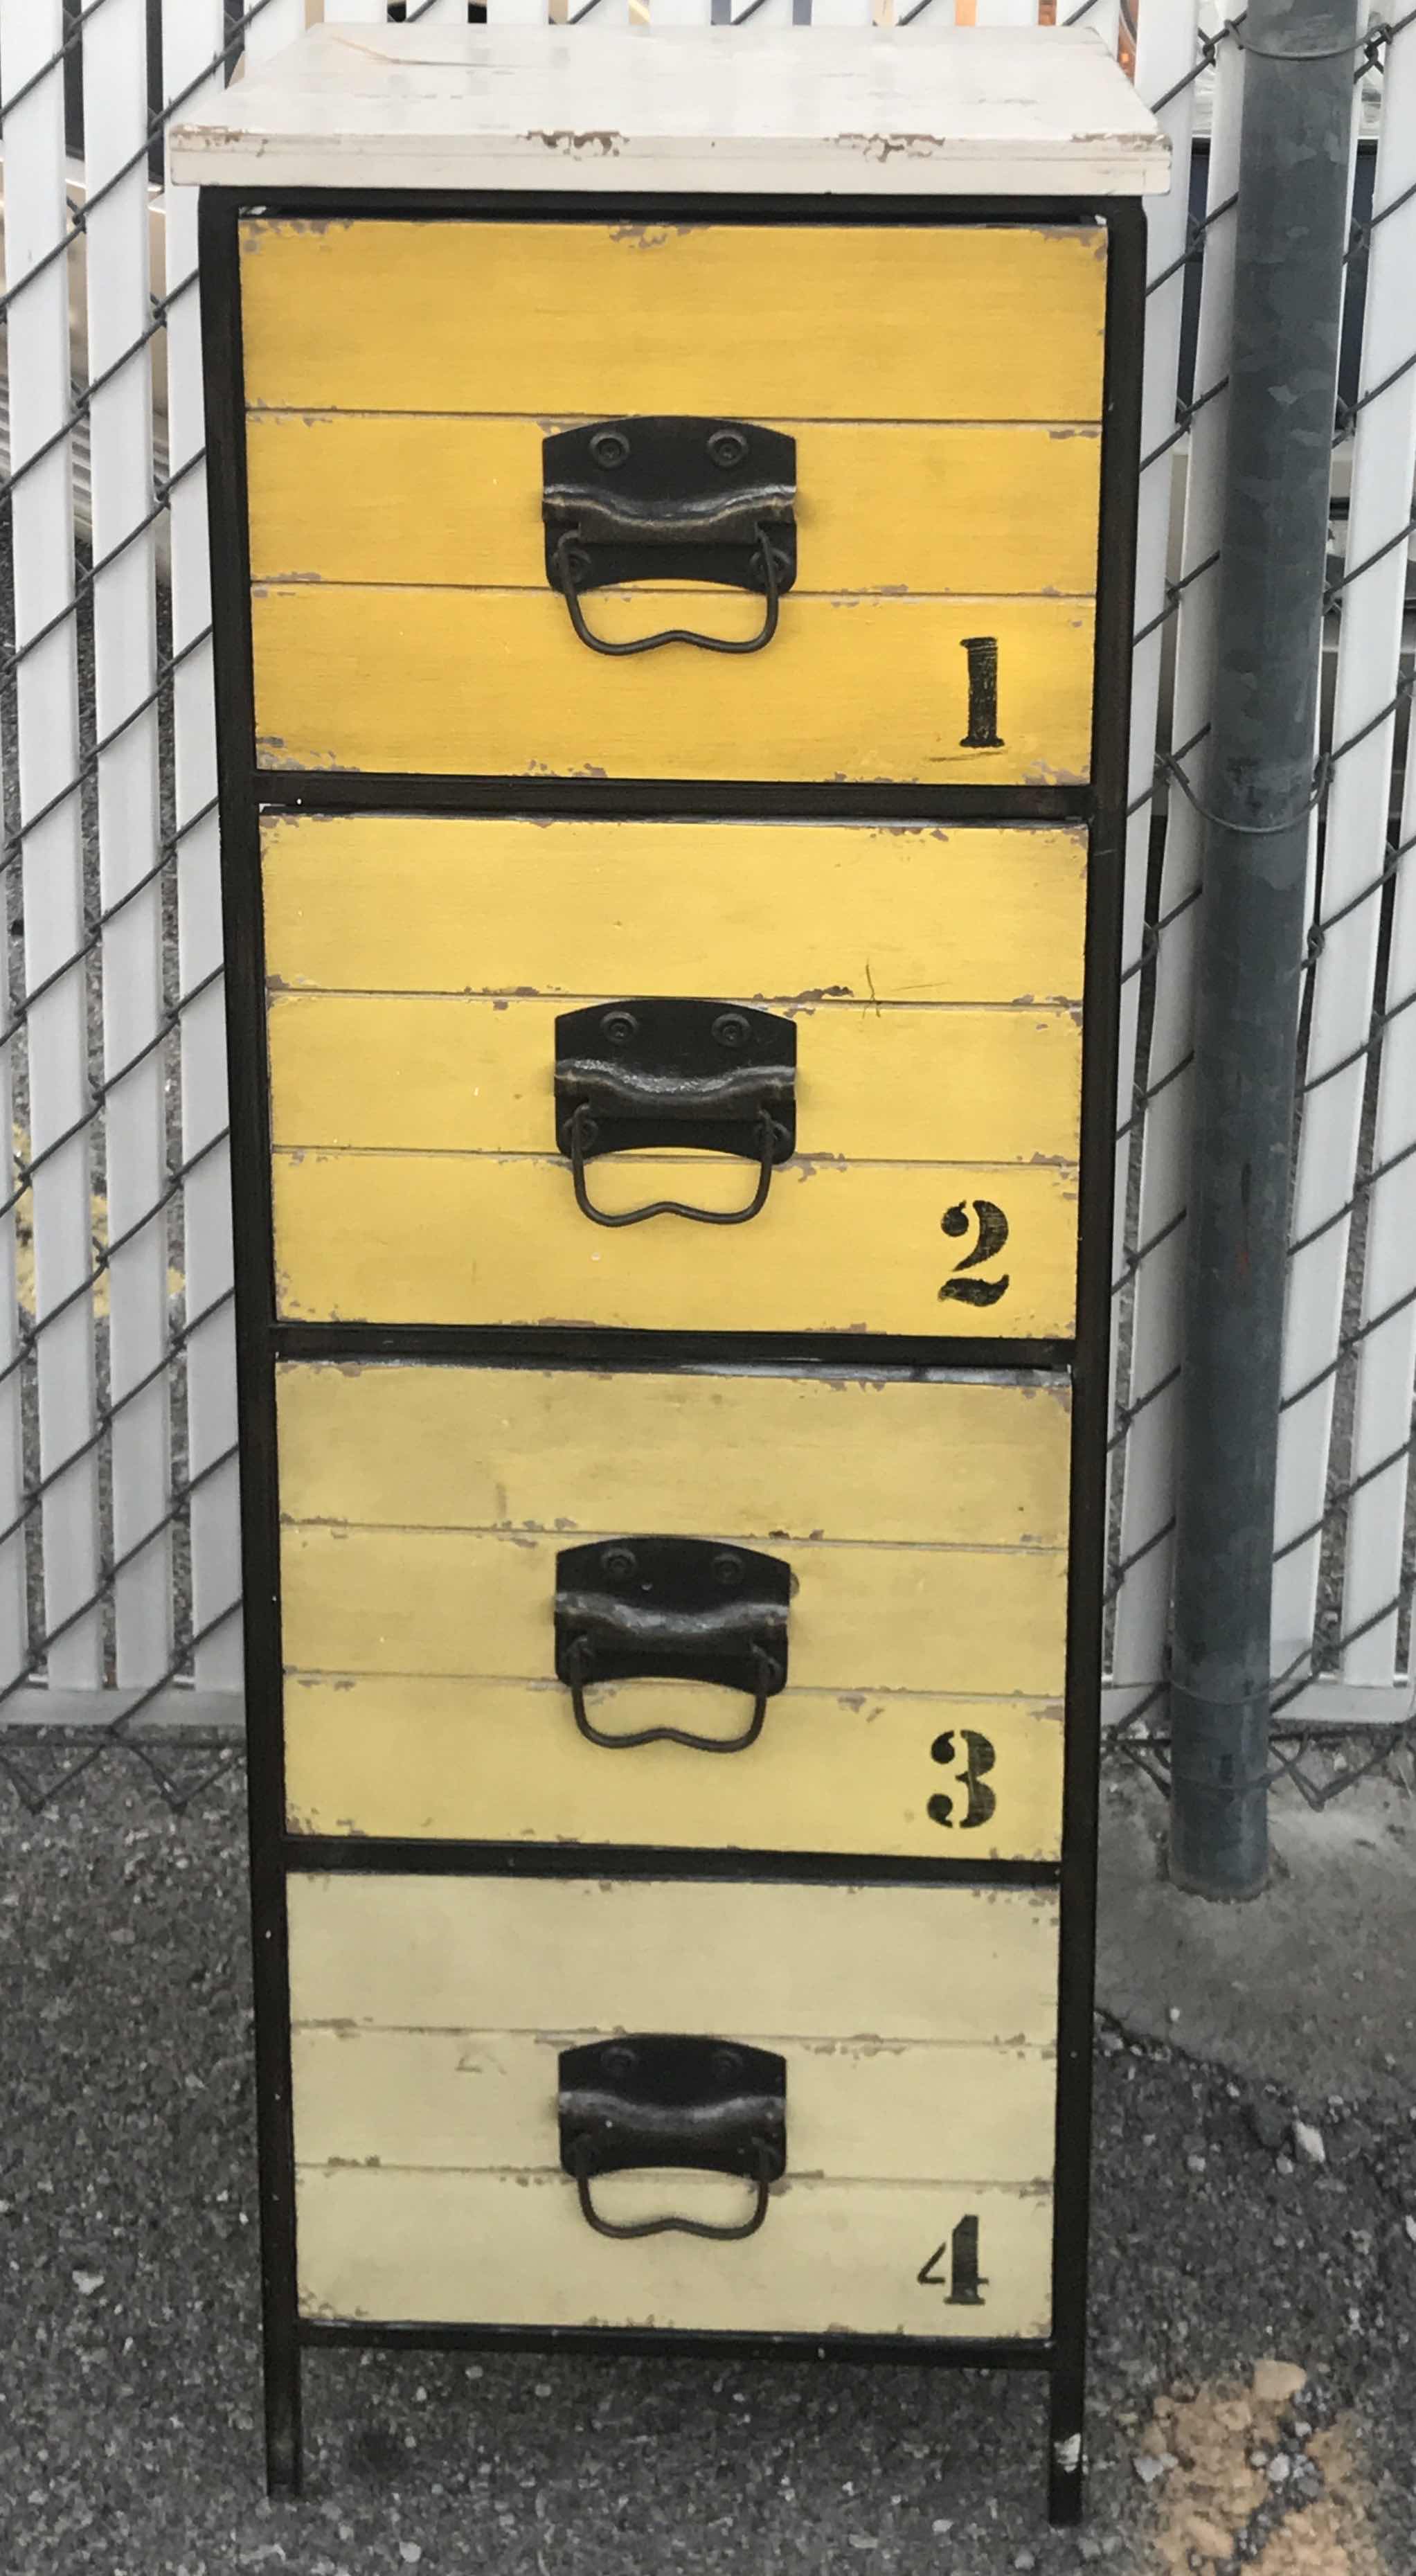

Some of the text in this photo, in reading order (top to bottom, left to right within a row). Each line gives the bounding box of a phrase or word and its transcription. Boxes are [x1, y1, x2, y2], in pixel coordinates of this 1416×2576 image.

[960, 636, 1005, 749] 1
[940, 1200, 1009, 1307] 2
[927, 1730, 996, 1828] 3
[917, 2215, 989, 2305] 4
